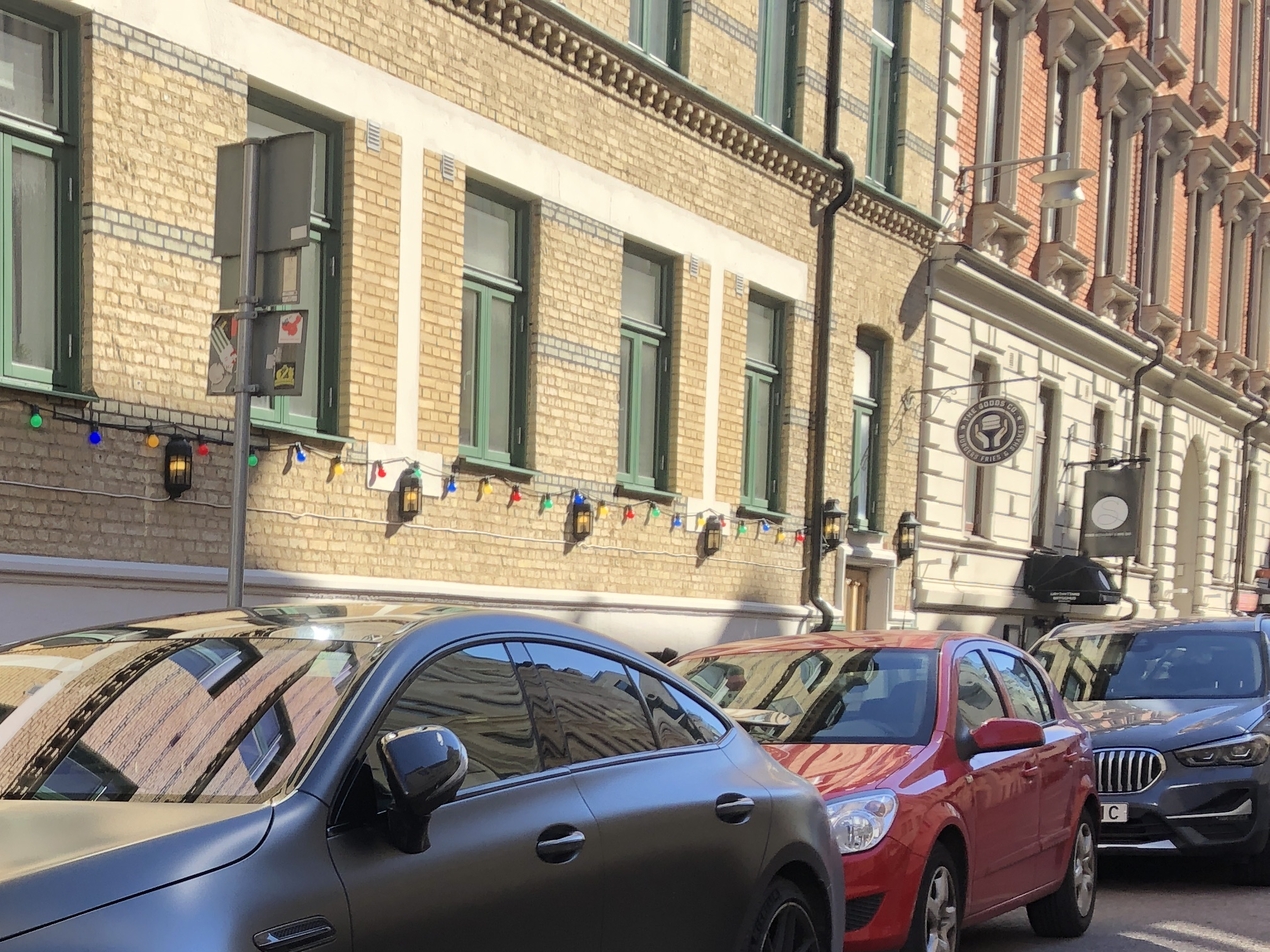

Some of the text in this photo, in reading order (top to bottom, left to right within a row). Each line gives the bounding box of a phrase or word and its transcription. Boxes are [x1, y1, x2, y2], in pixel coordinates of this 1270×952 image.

[963, 408, 978, 421] THE
[978, 400, 1006, 409] GOODS
[958, 434, 980, 460] BURGERS
[980, 454, 1002, 463] FRIES
[1009, 424, 1025, 452] SHAKES
